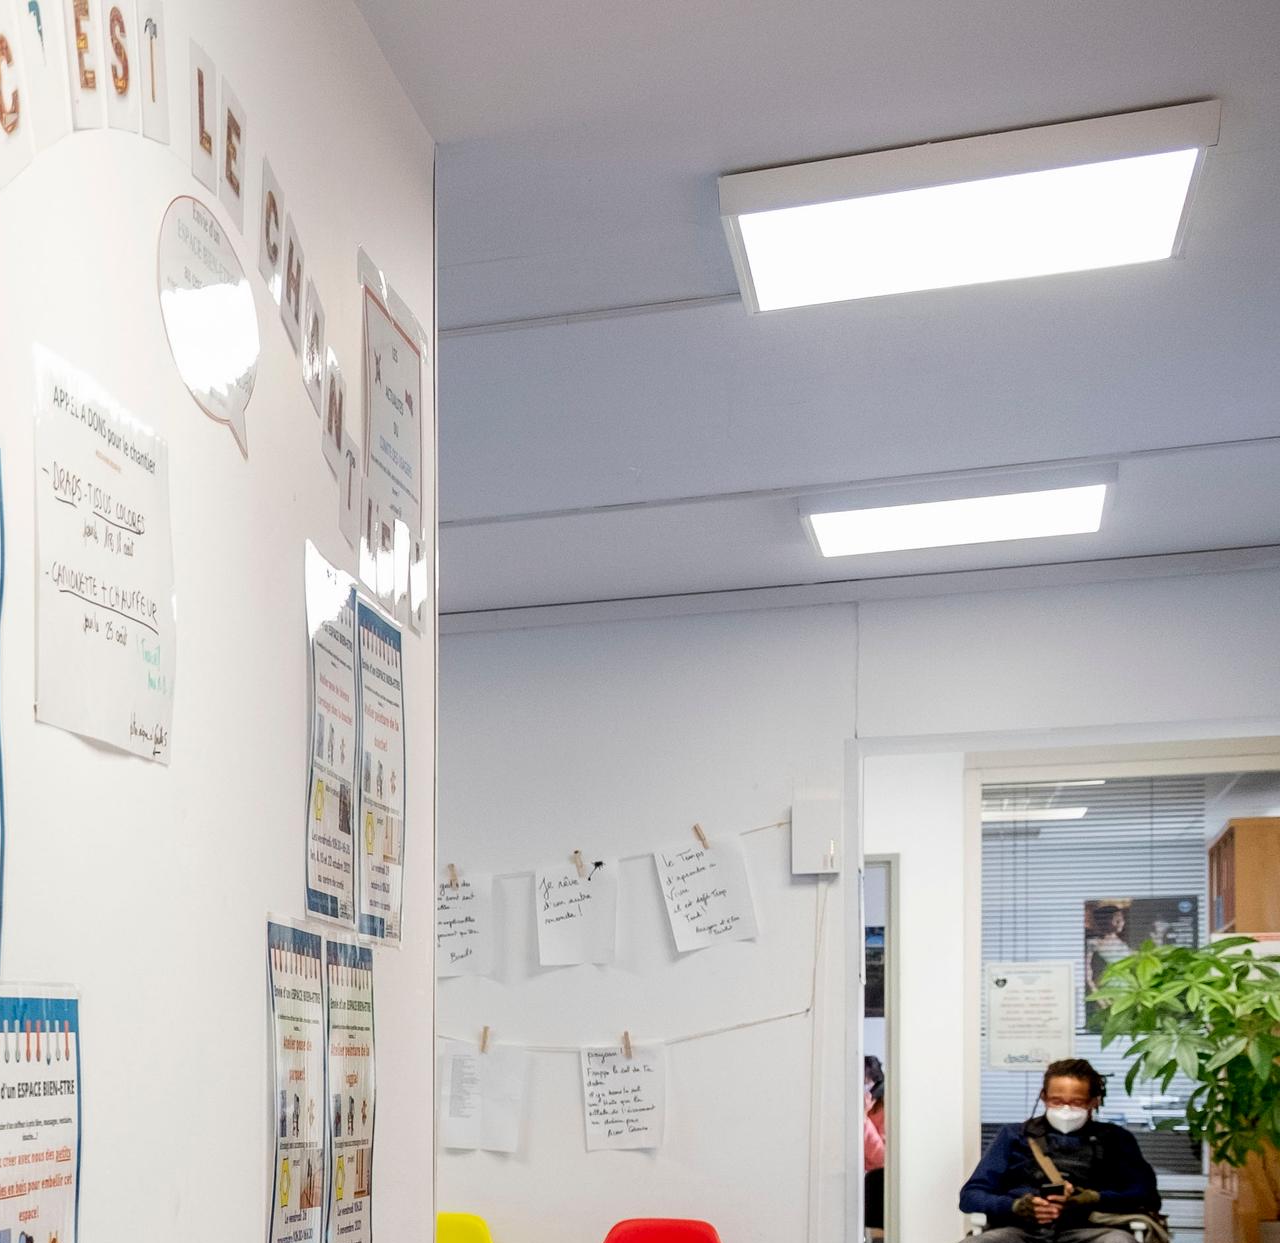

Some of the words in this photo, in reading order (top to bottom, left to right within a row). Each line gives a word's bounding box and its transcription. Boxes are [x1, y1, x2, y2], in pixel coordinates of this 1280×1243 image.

[196, 67, 241, 198] LE
[88, 407, 107, 440] DONS
[107, 428, 122, 451] pour
[129, 443, 156, 475] chantier
